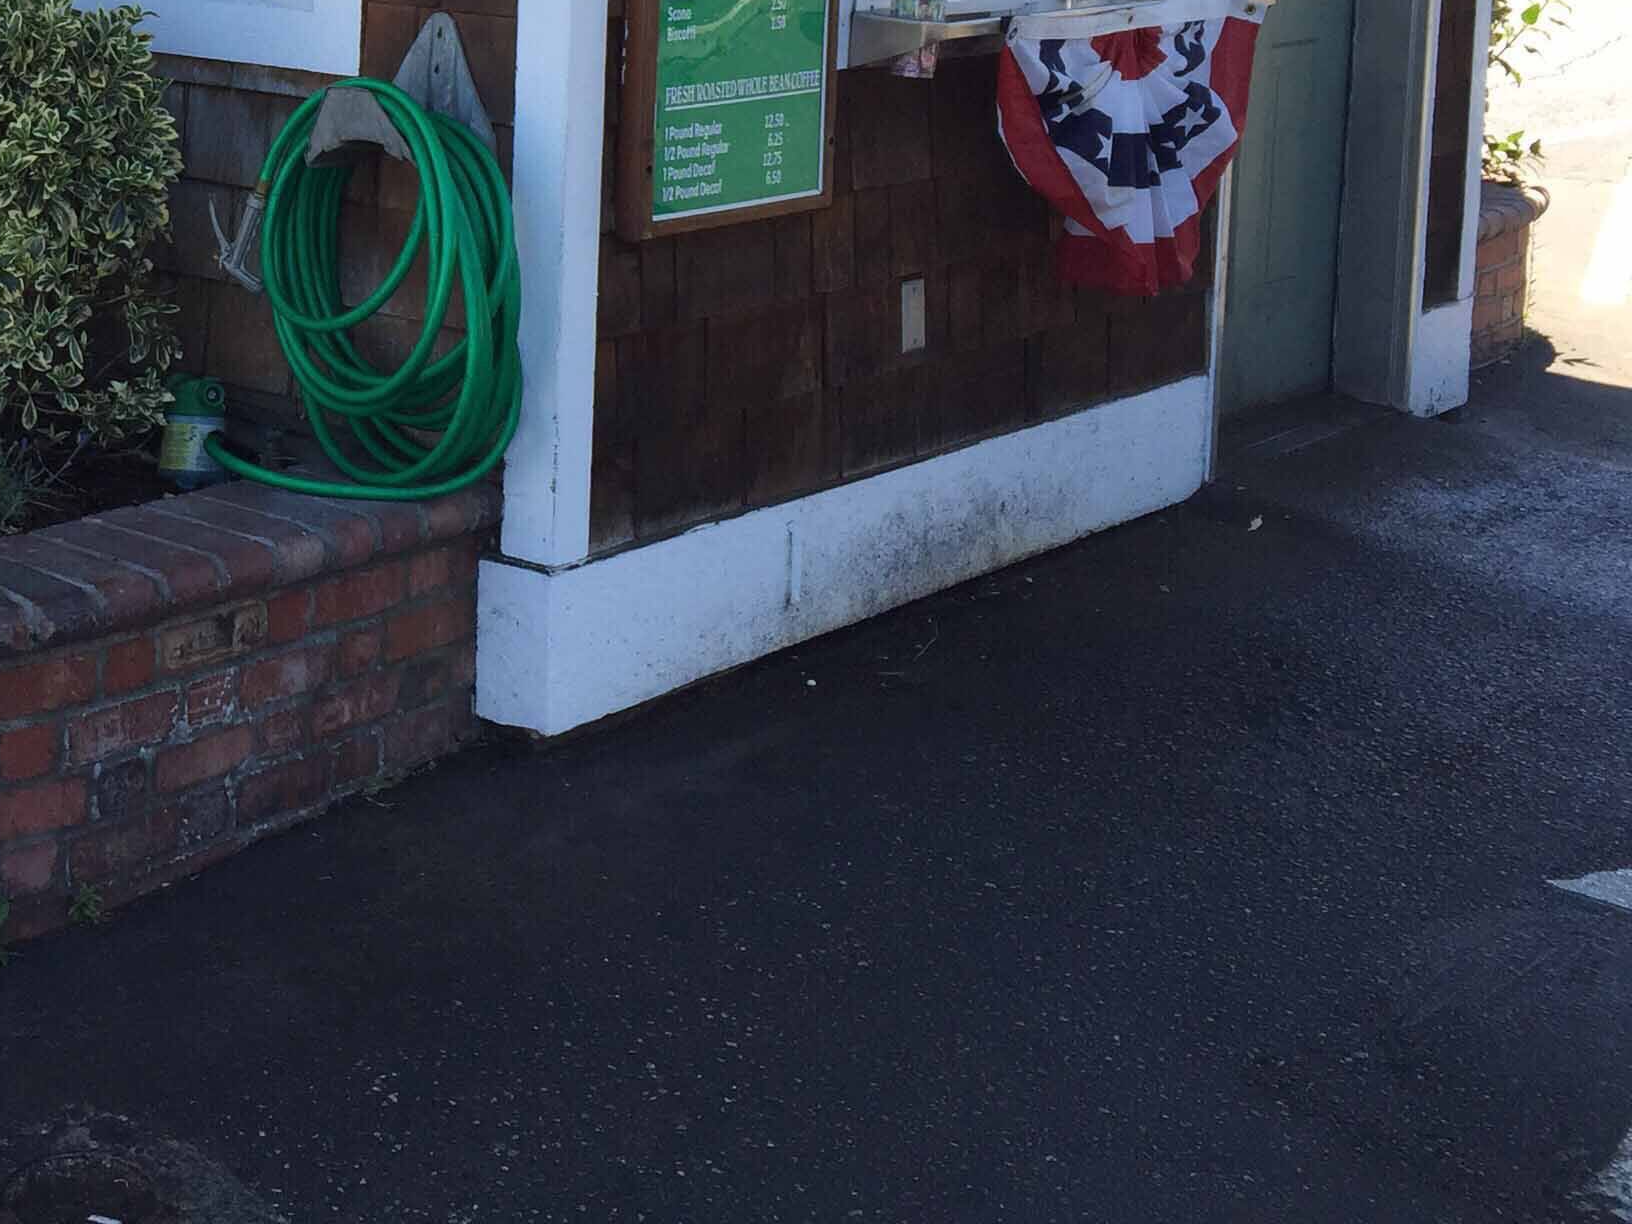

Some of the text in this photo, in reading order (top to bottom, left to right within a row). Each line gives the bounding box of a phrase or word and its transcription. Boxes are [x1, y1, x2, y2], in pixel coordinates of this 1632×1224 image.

[666, 86, 695, 104] FRESH
[696, 80, 736, 102] ROASTED
[669, 125, 693, 139] Pound
[695, 120, 722, 139] Regular
[677, 144, 700, 159] Pound
[701, 141, 729, 158] Regular
[668, 164, 692, 180] Pound
[693, 160, 715, 176] Decaf
[675, 185, 699, 199] Pound
